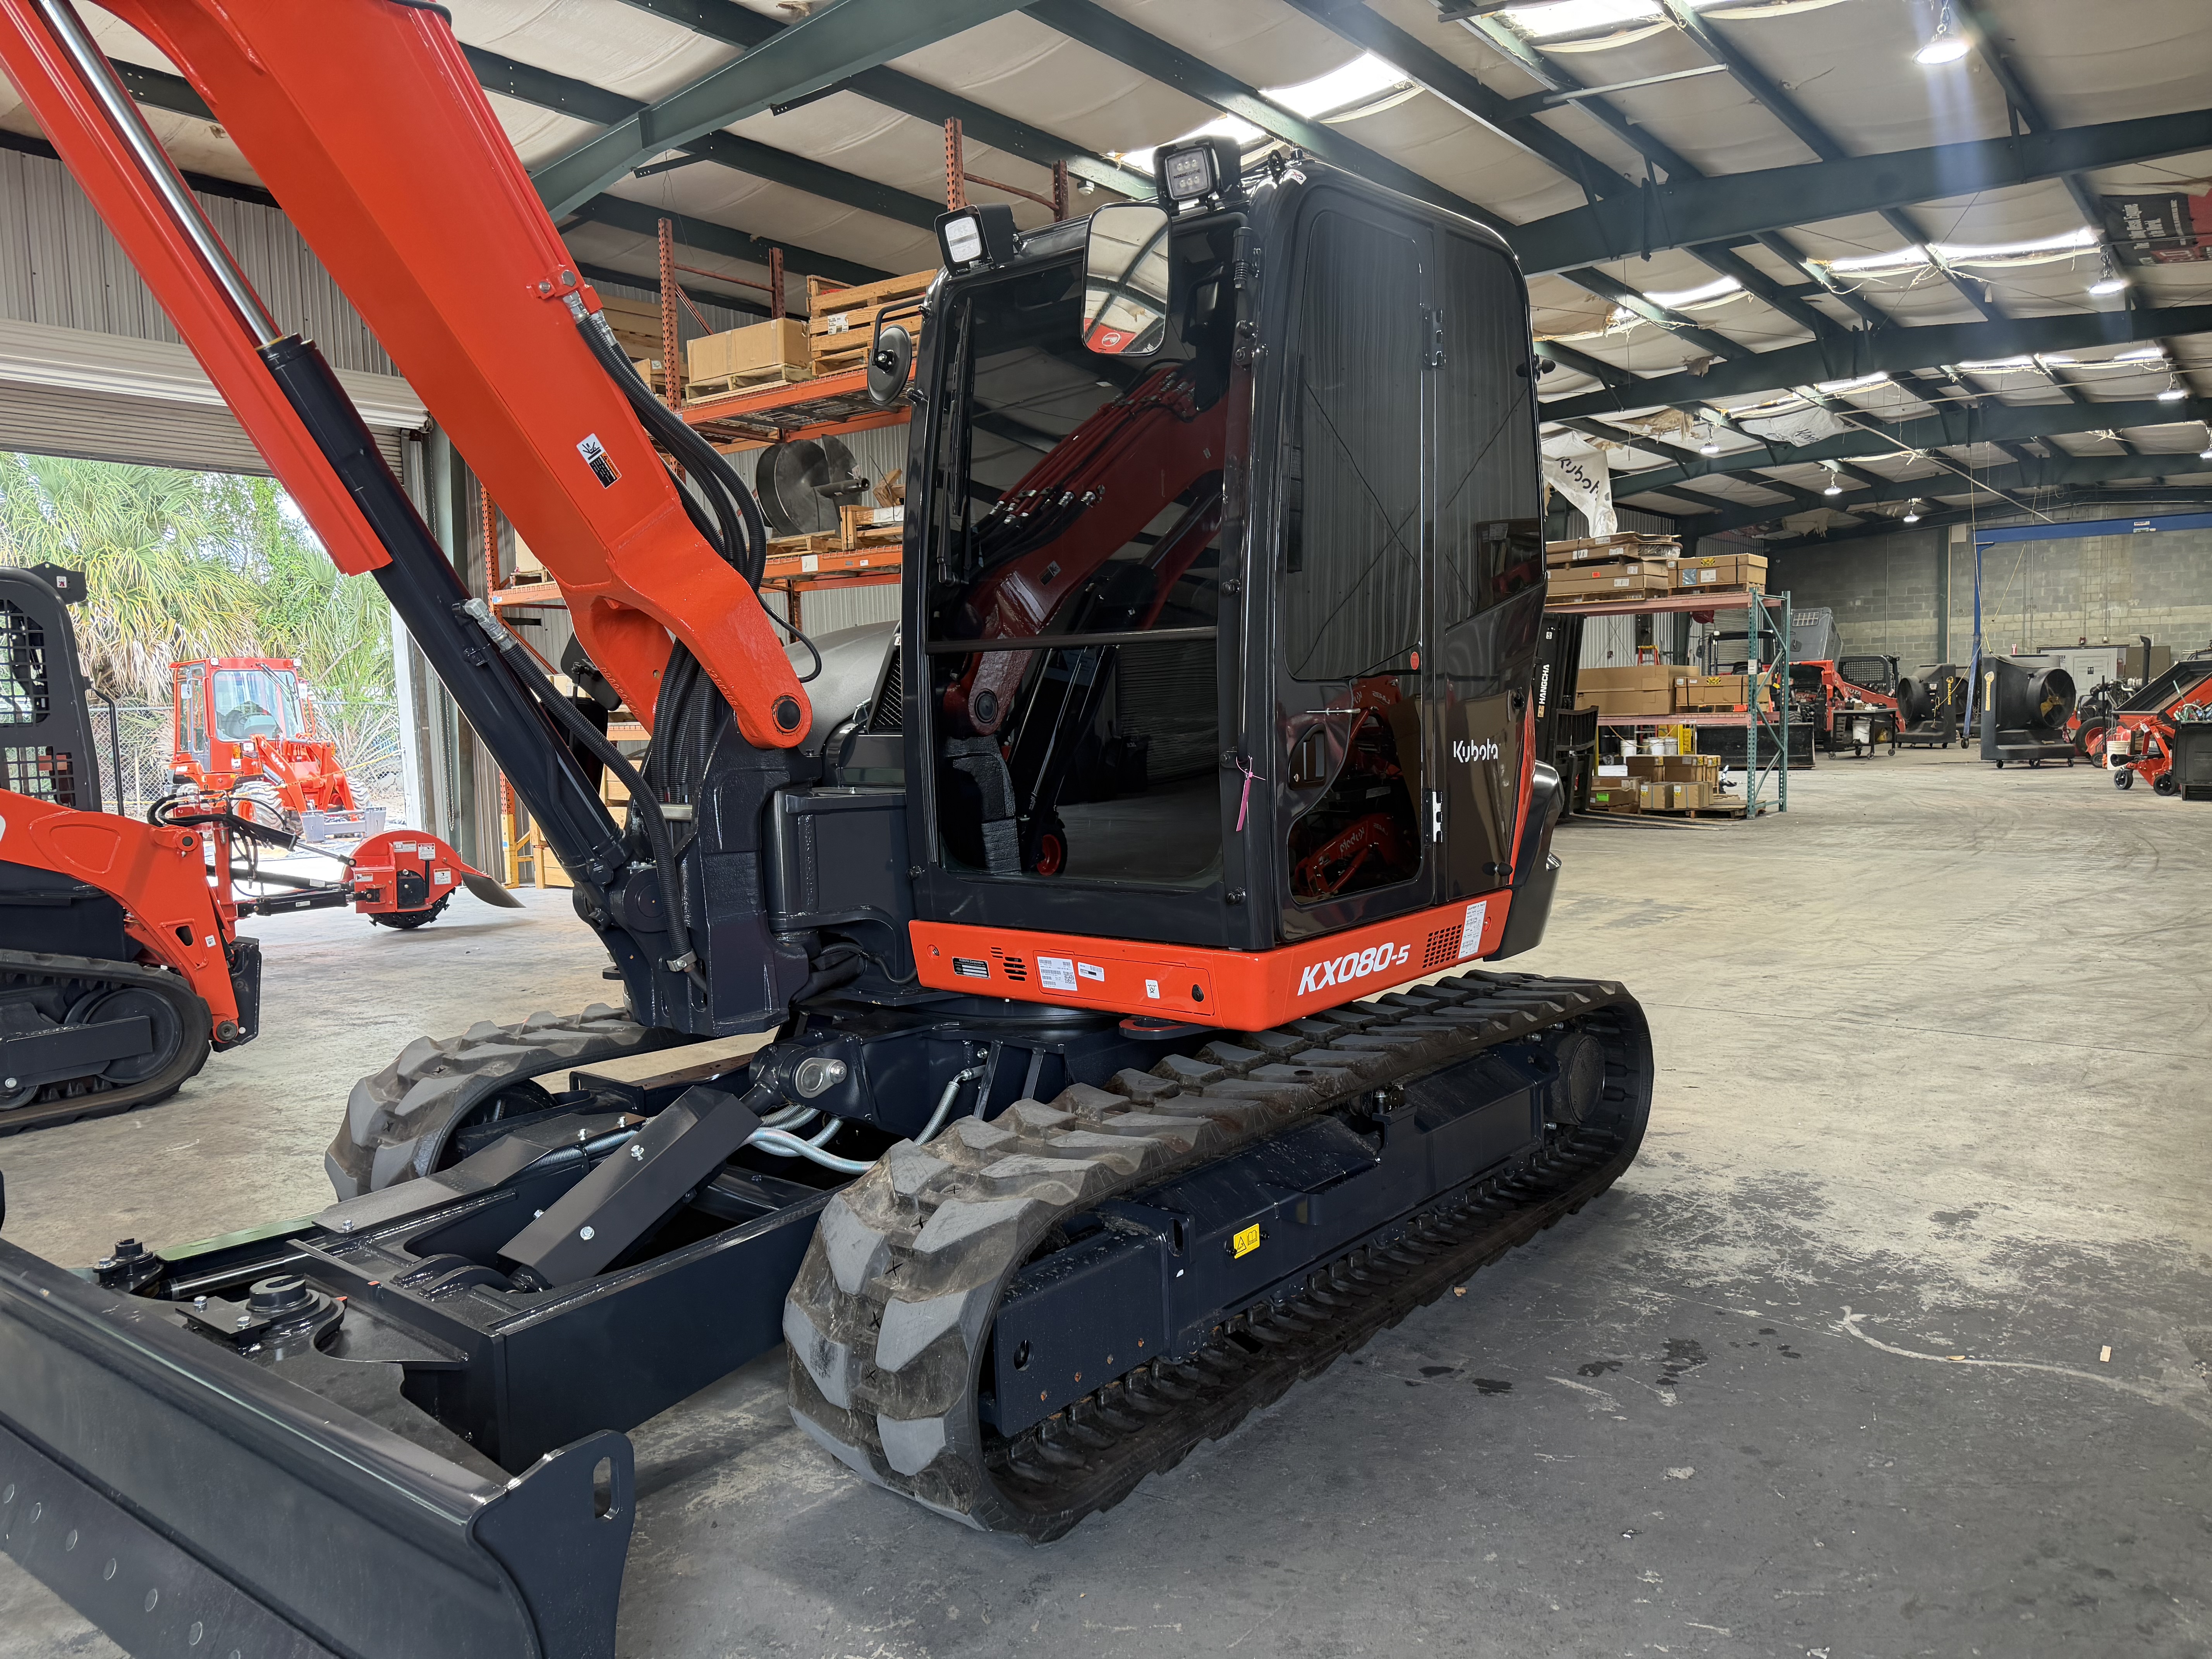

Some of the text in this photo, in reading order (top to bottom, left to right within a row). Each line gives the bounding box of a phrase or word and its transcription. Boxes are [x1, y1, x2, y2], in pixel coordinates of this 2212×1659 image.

[1555, 456, 1601, 501] Kubot
[1539, 664, 1550, 705] HANGCHA
[1453, 738, 1498, 763] Kubota
